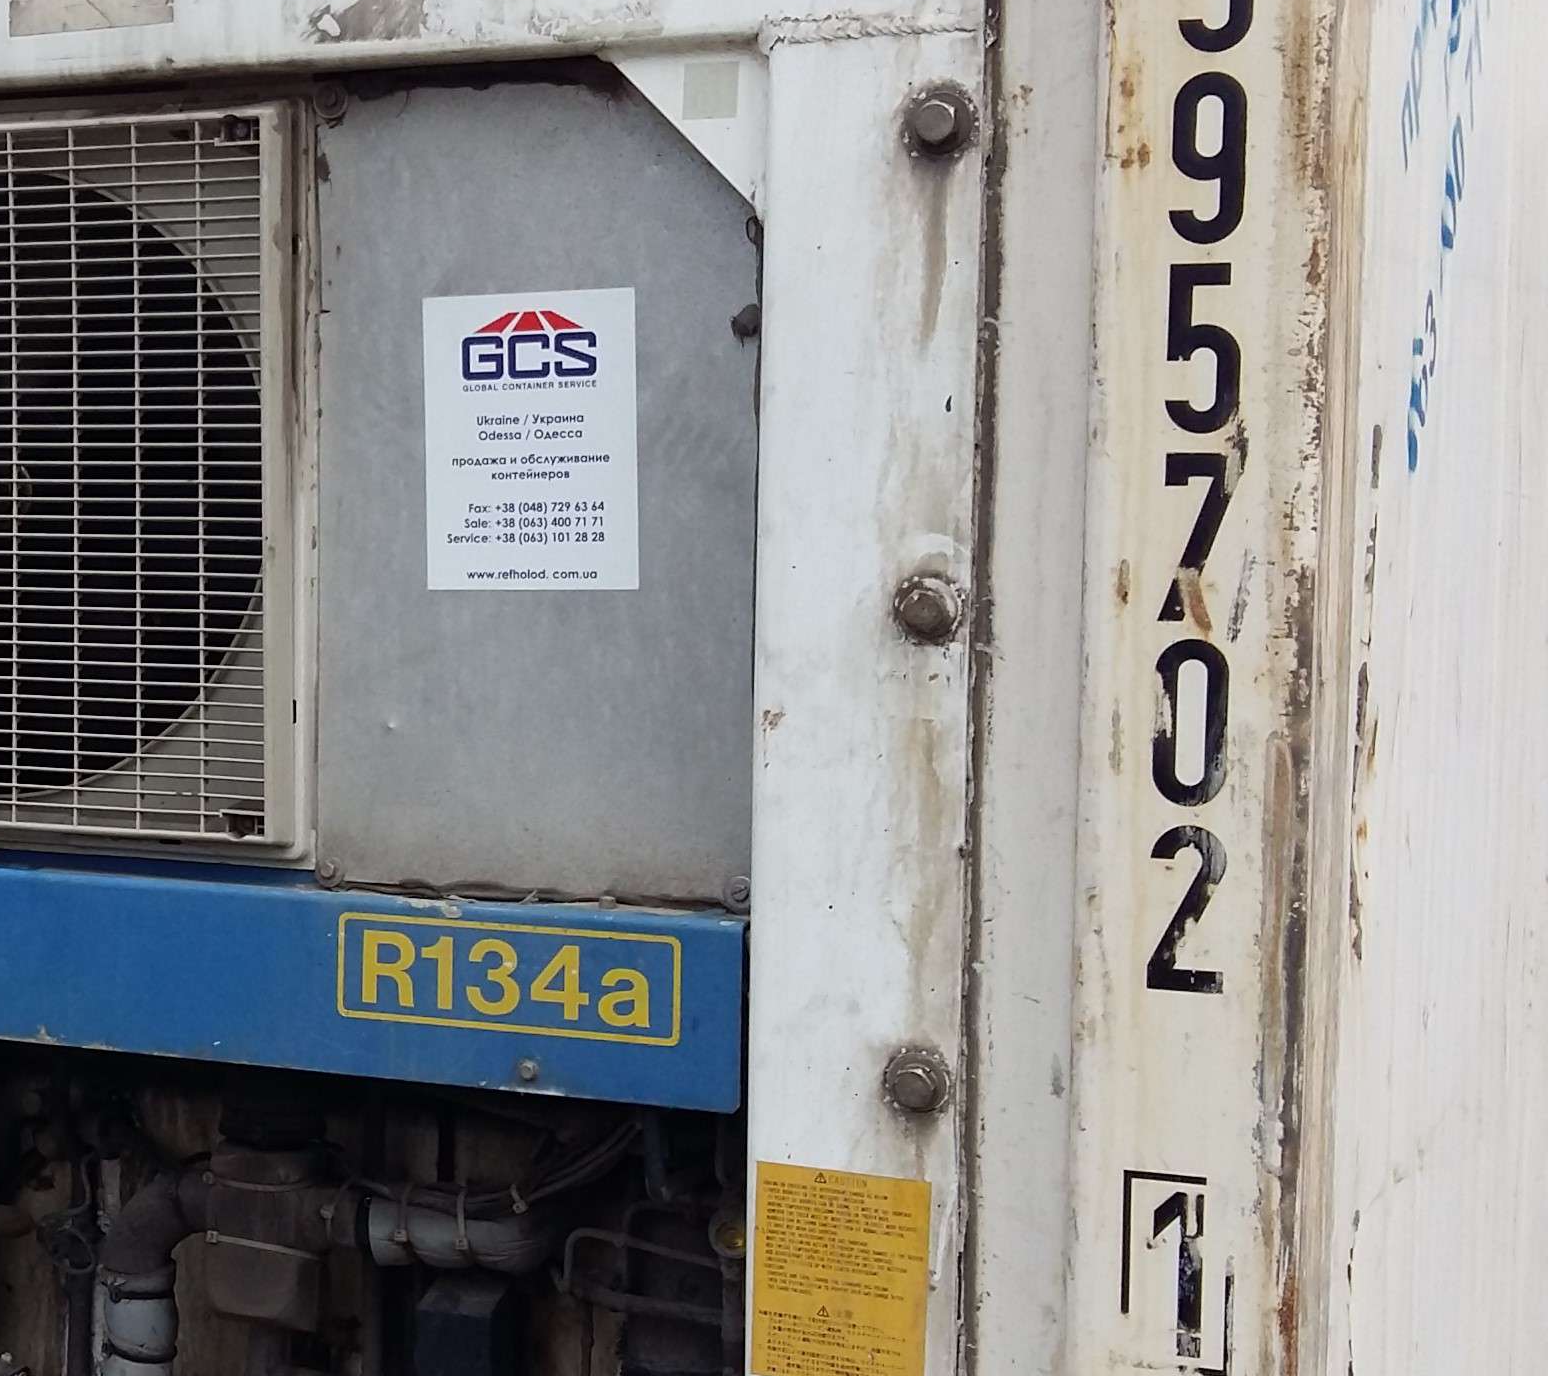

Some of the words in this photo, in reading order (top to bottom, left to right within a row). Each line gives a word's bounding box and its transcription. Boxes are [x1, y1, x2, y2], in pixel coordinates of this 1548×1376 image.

[462, 331, 597, 380] GCS
[463, 384, 498, 392] GLOBAL
[502, 382, 555, 391] CONTAINER
[558, 380, 597, 389] SERVICE
[476, 415, 520, 426] Ukraine
[532, 414, 584, 427] Украина
[479, 430, 522, 441] Odessa
[534, 429, 583, 440] Одесса
[452, 455, 506, 468] продажа
[510, 457, 517, 465] и
[520, 453, 610, 467] обслуживание
[491, 469, 570, 482] контейнеров
[469, 503, 491, 513] Fax:
[495, 503, 515, 513] +38
[518, 501, 547, 515] (048)
[551, 502, 570, 512] 729
[574, 502, 588, 511] 63
[592, 501, 604, 511] 64
[465, 519, 491, 529] Sale:
[495, 518, 515, 528] +38
[518, 517, 547, 531] (063)
[551, 517, 571, 527] 400
[574, 517, 588, 527] 71
[592, 517, 604, 527] 71
[447, 534, 491, 544] Service:
[495, 533, 515, 543] +38
[518, 532, 547, 545] (063)
[552, 532, 570, 542] 101
[574, 532, 588, 542] 28
[592, 532, 605, 542] 28
[361, 929, 651, 1028] R134a
